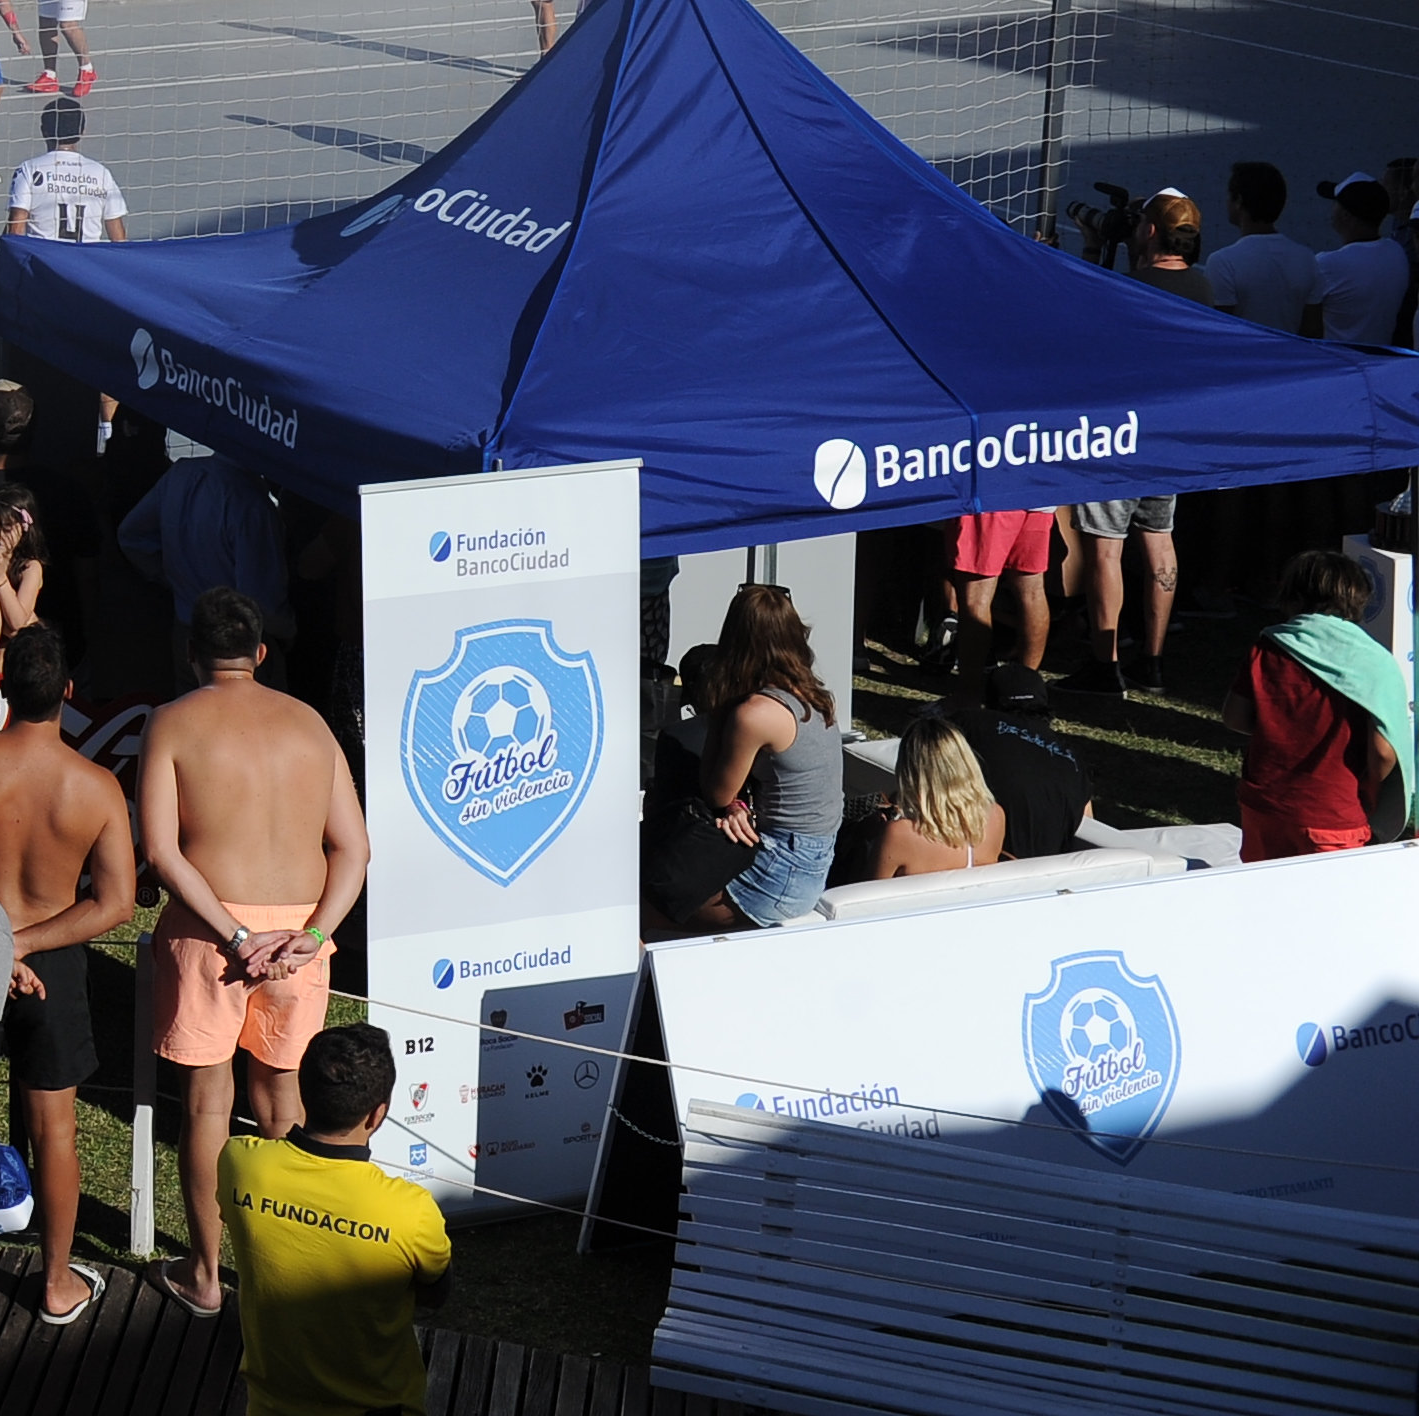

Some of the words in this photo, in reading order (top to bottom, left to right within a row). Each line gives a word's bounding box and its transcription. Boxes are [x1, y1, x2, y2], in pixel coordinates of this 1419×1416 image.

[46, 171, 98, 185] Fundación
[47, 183, 108, 199] BancoCiudad
[161, 348, 299, 449] BancoCiudad
[874, 411, 1139, 488] BancoCiudad
[456, 528, 546, 553] Fundación
[456, 547, 569, 577] BancoCiudad
[444, 733, 554, 801] Fútbol
[461, 800, 490, 823] sin
[494, 771, 570, 811] violencia
[459, 944, 572, 979] BancoCiudad
[1064, 1040, 1145, 1098] Fútbol
[524, 1090, 550, 1100] KELME
[772, 1082, 900, 1121] Fundación
[1080, 1095, 1101, 1116] sin
[1104, 1071, 1160, 1104] violencia
[233, 1187, 254, 1211] LA
[260, 1197, 391, 1244] FUNDACION
